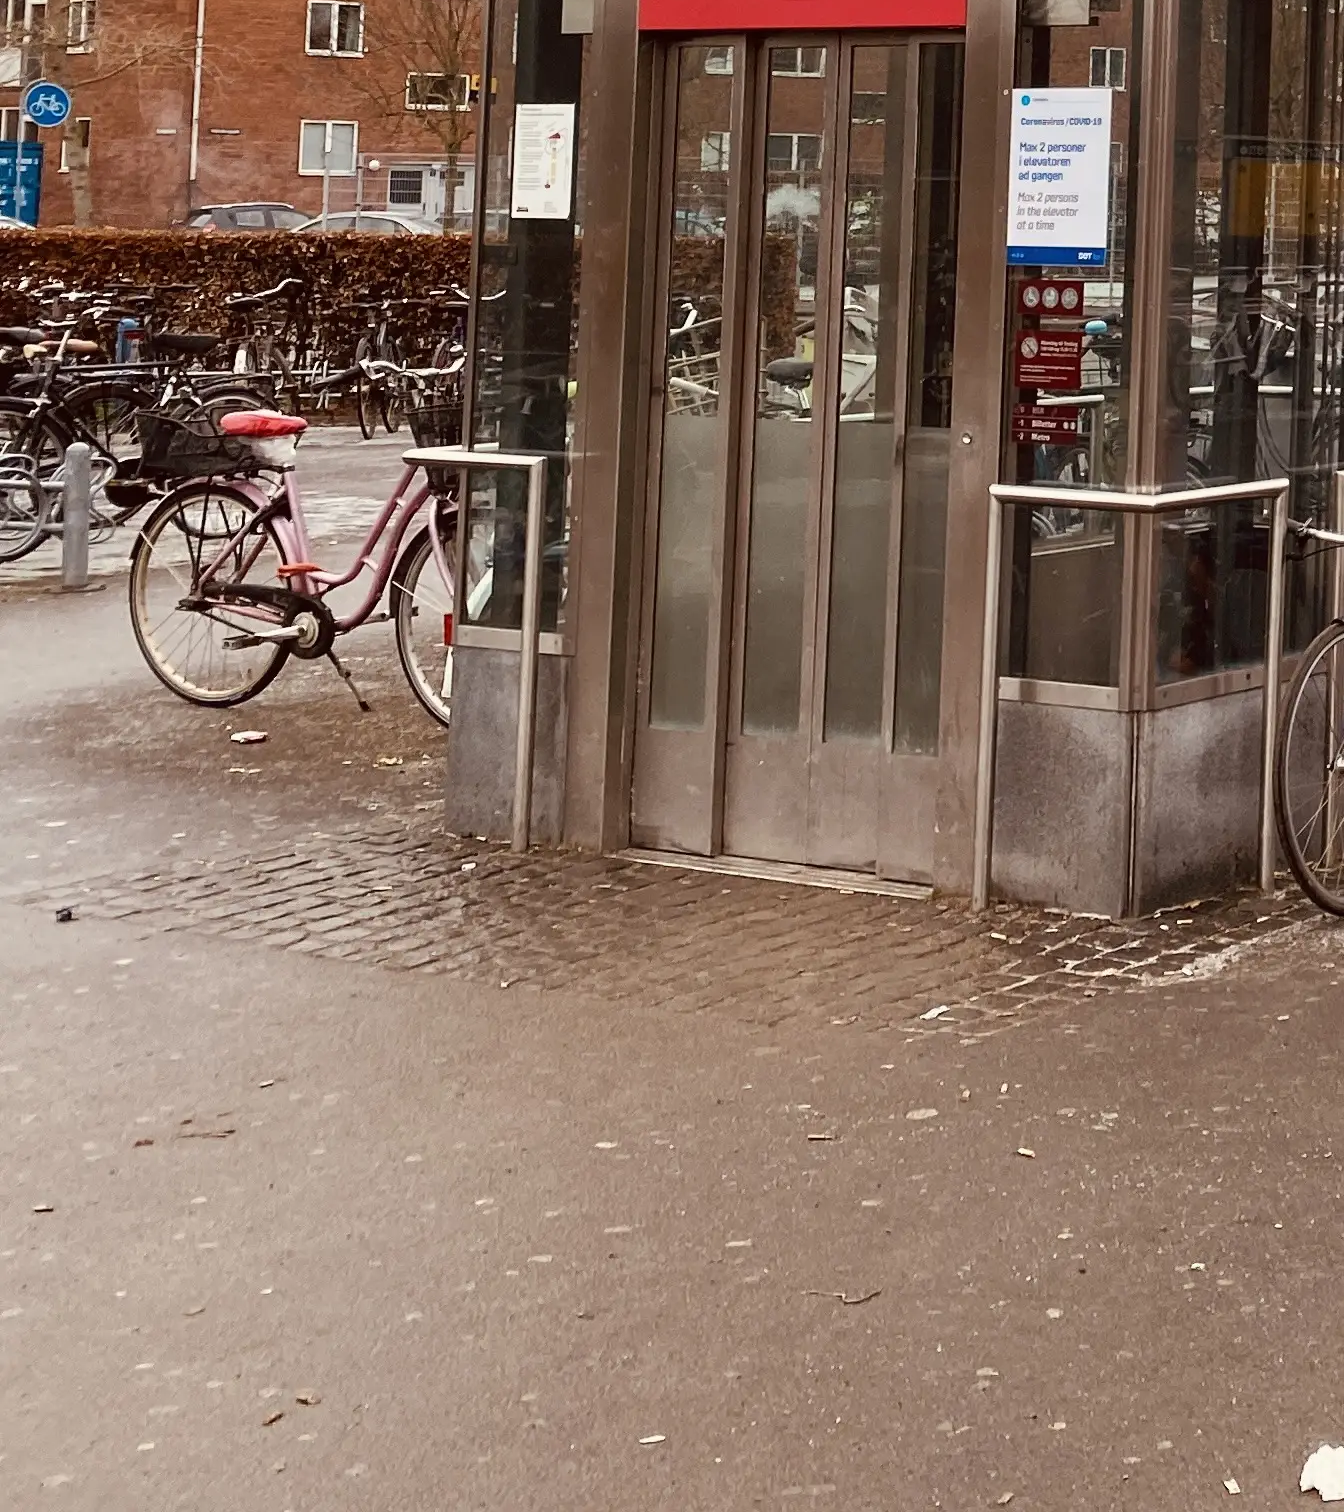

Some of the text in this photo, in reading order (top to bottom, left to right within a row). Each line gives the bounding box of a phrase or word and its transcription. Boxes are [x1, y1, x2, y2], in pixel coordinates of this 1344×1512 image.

[1019, 141, 1087, 154] Max 2 personer
[1023, 155, 1071, 167] elevatoren
[1018, 170, 1064, 183] ad gangen
[1017, 191, 1079, 205] Max 2 persons
[1016, 204, 1079, 217] in the elevator
[1016, 220, 1027, 231] at
[1035, 219, 1055, 231] time
